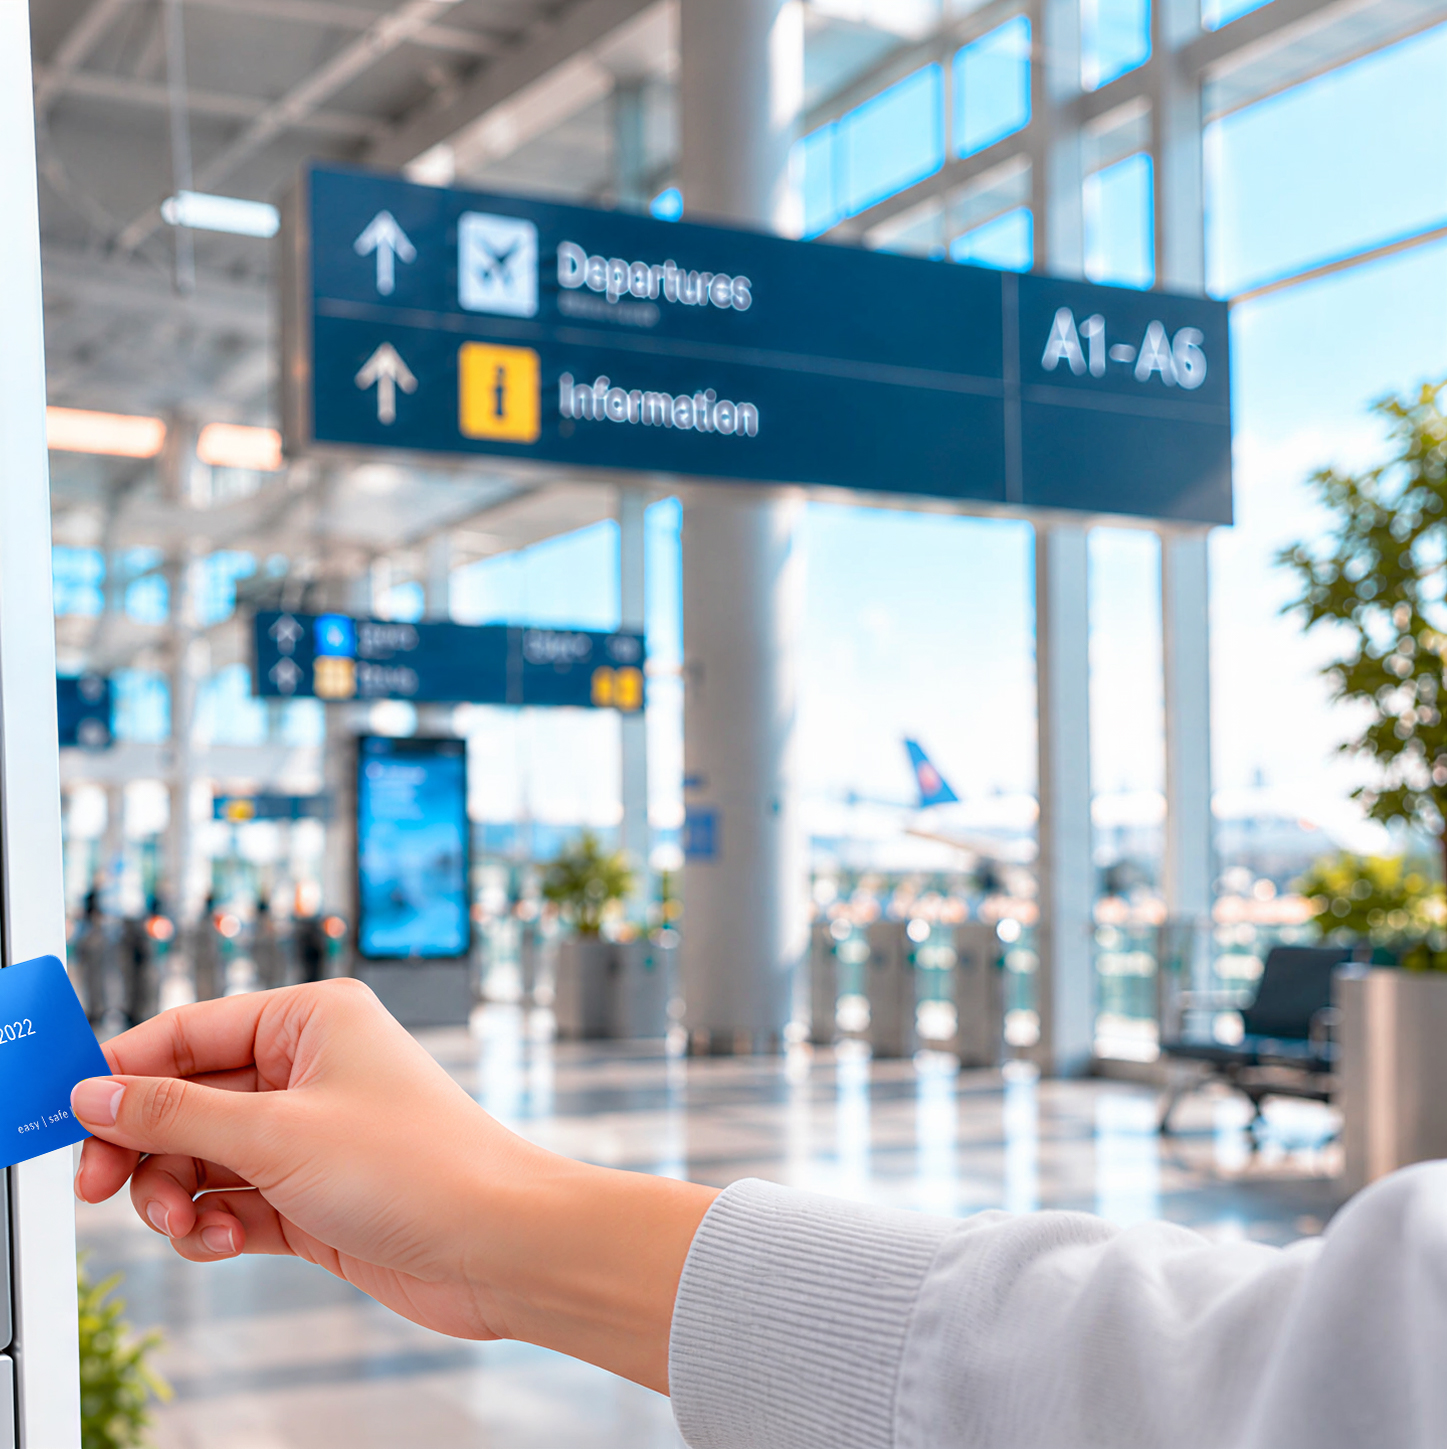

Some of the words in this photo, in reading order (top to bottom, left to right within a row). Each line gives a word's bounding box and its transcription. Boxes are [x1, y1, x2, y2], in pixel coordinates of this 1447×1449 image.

[556, 239, 753, 311] Departures
[1040, 306, 1208, 390] A1-A6
[557, 372, 760, 438] Information
[17, 1119, 40, 1135] easy
[48, 1108, 69, 1125] safe
